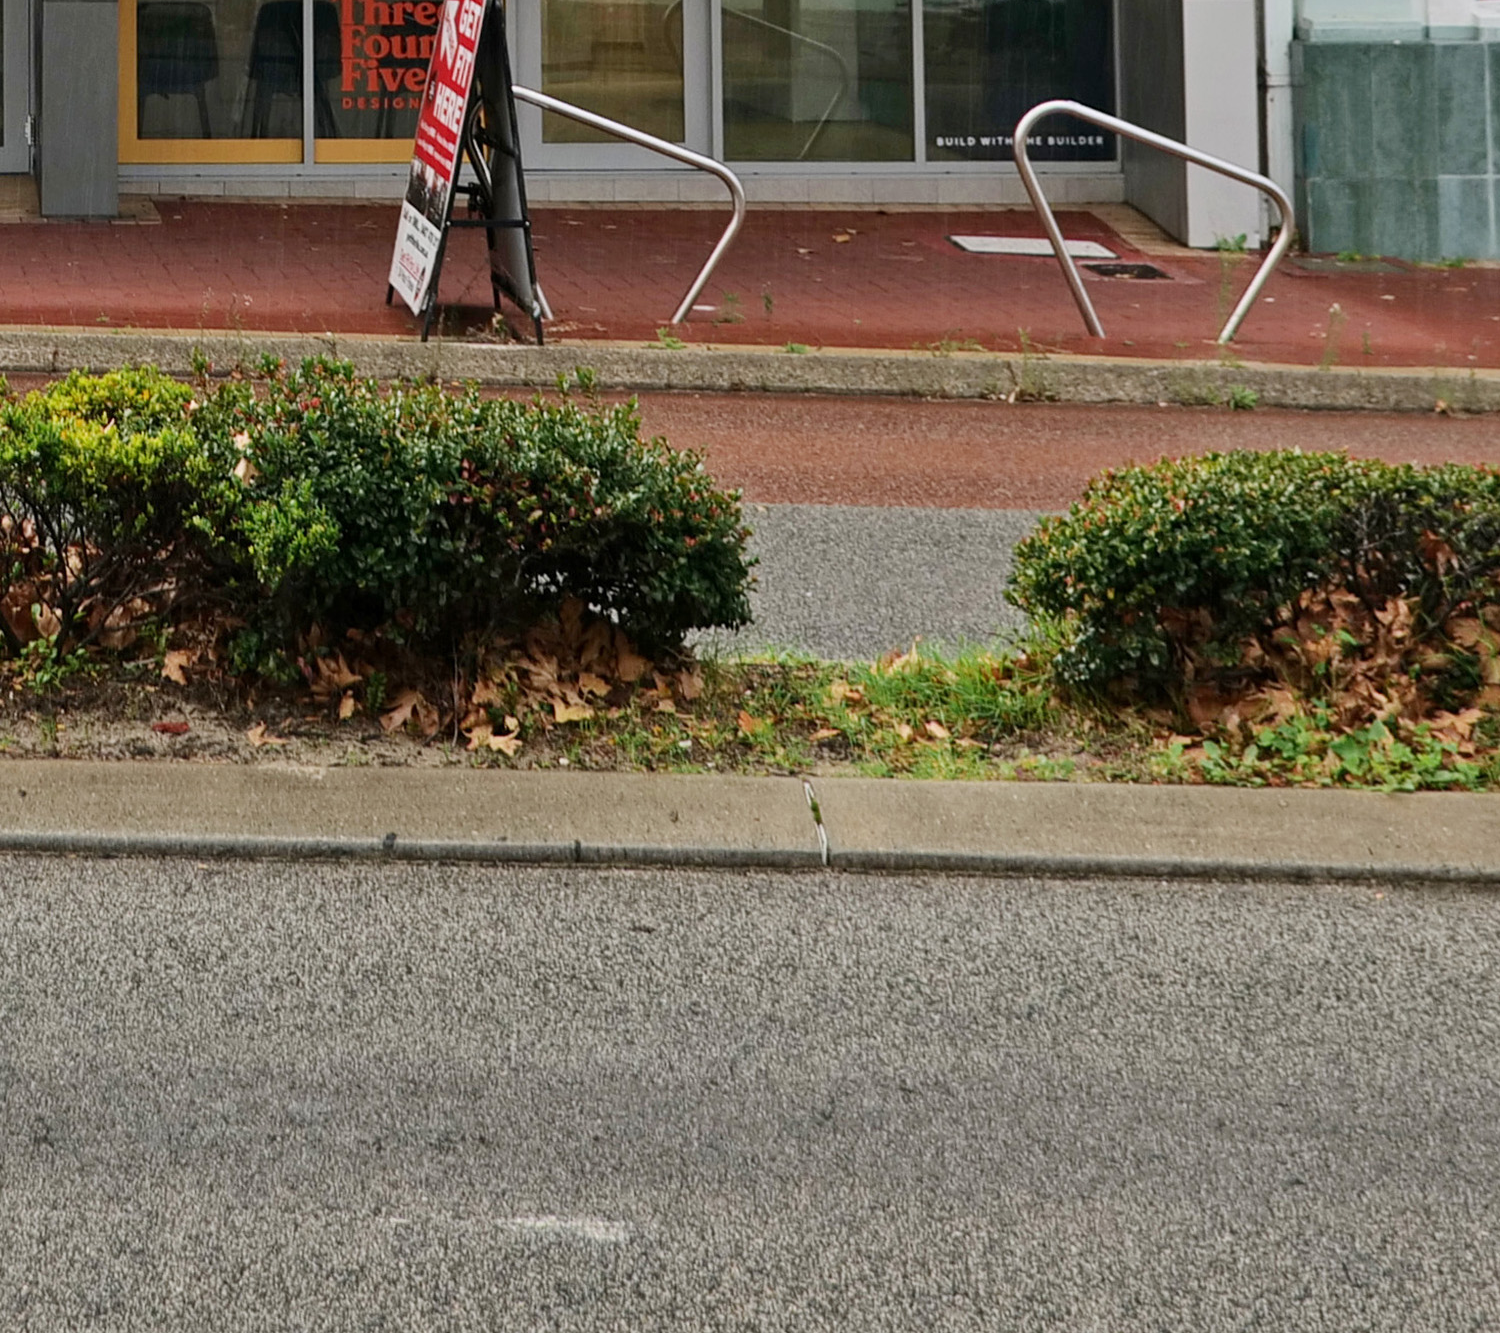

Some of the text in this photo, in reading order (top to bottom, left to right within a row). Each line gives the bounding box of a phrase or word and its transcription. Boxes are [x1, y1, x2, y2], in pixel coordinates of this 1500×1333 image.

[340, 57, 426, 92] Five
[452, 44, 474, 89] FIT
[433, 81, 465, 134] HERE
[936, 136, 1104, 146] BUILD WITH HE BUILDER
